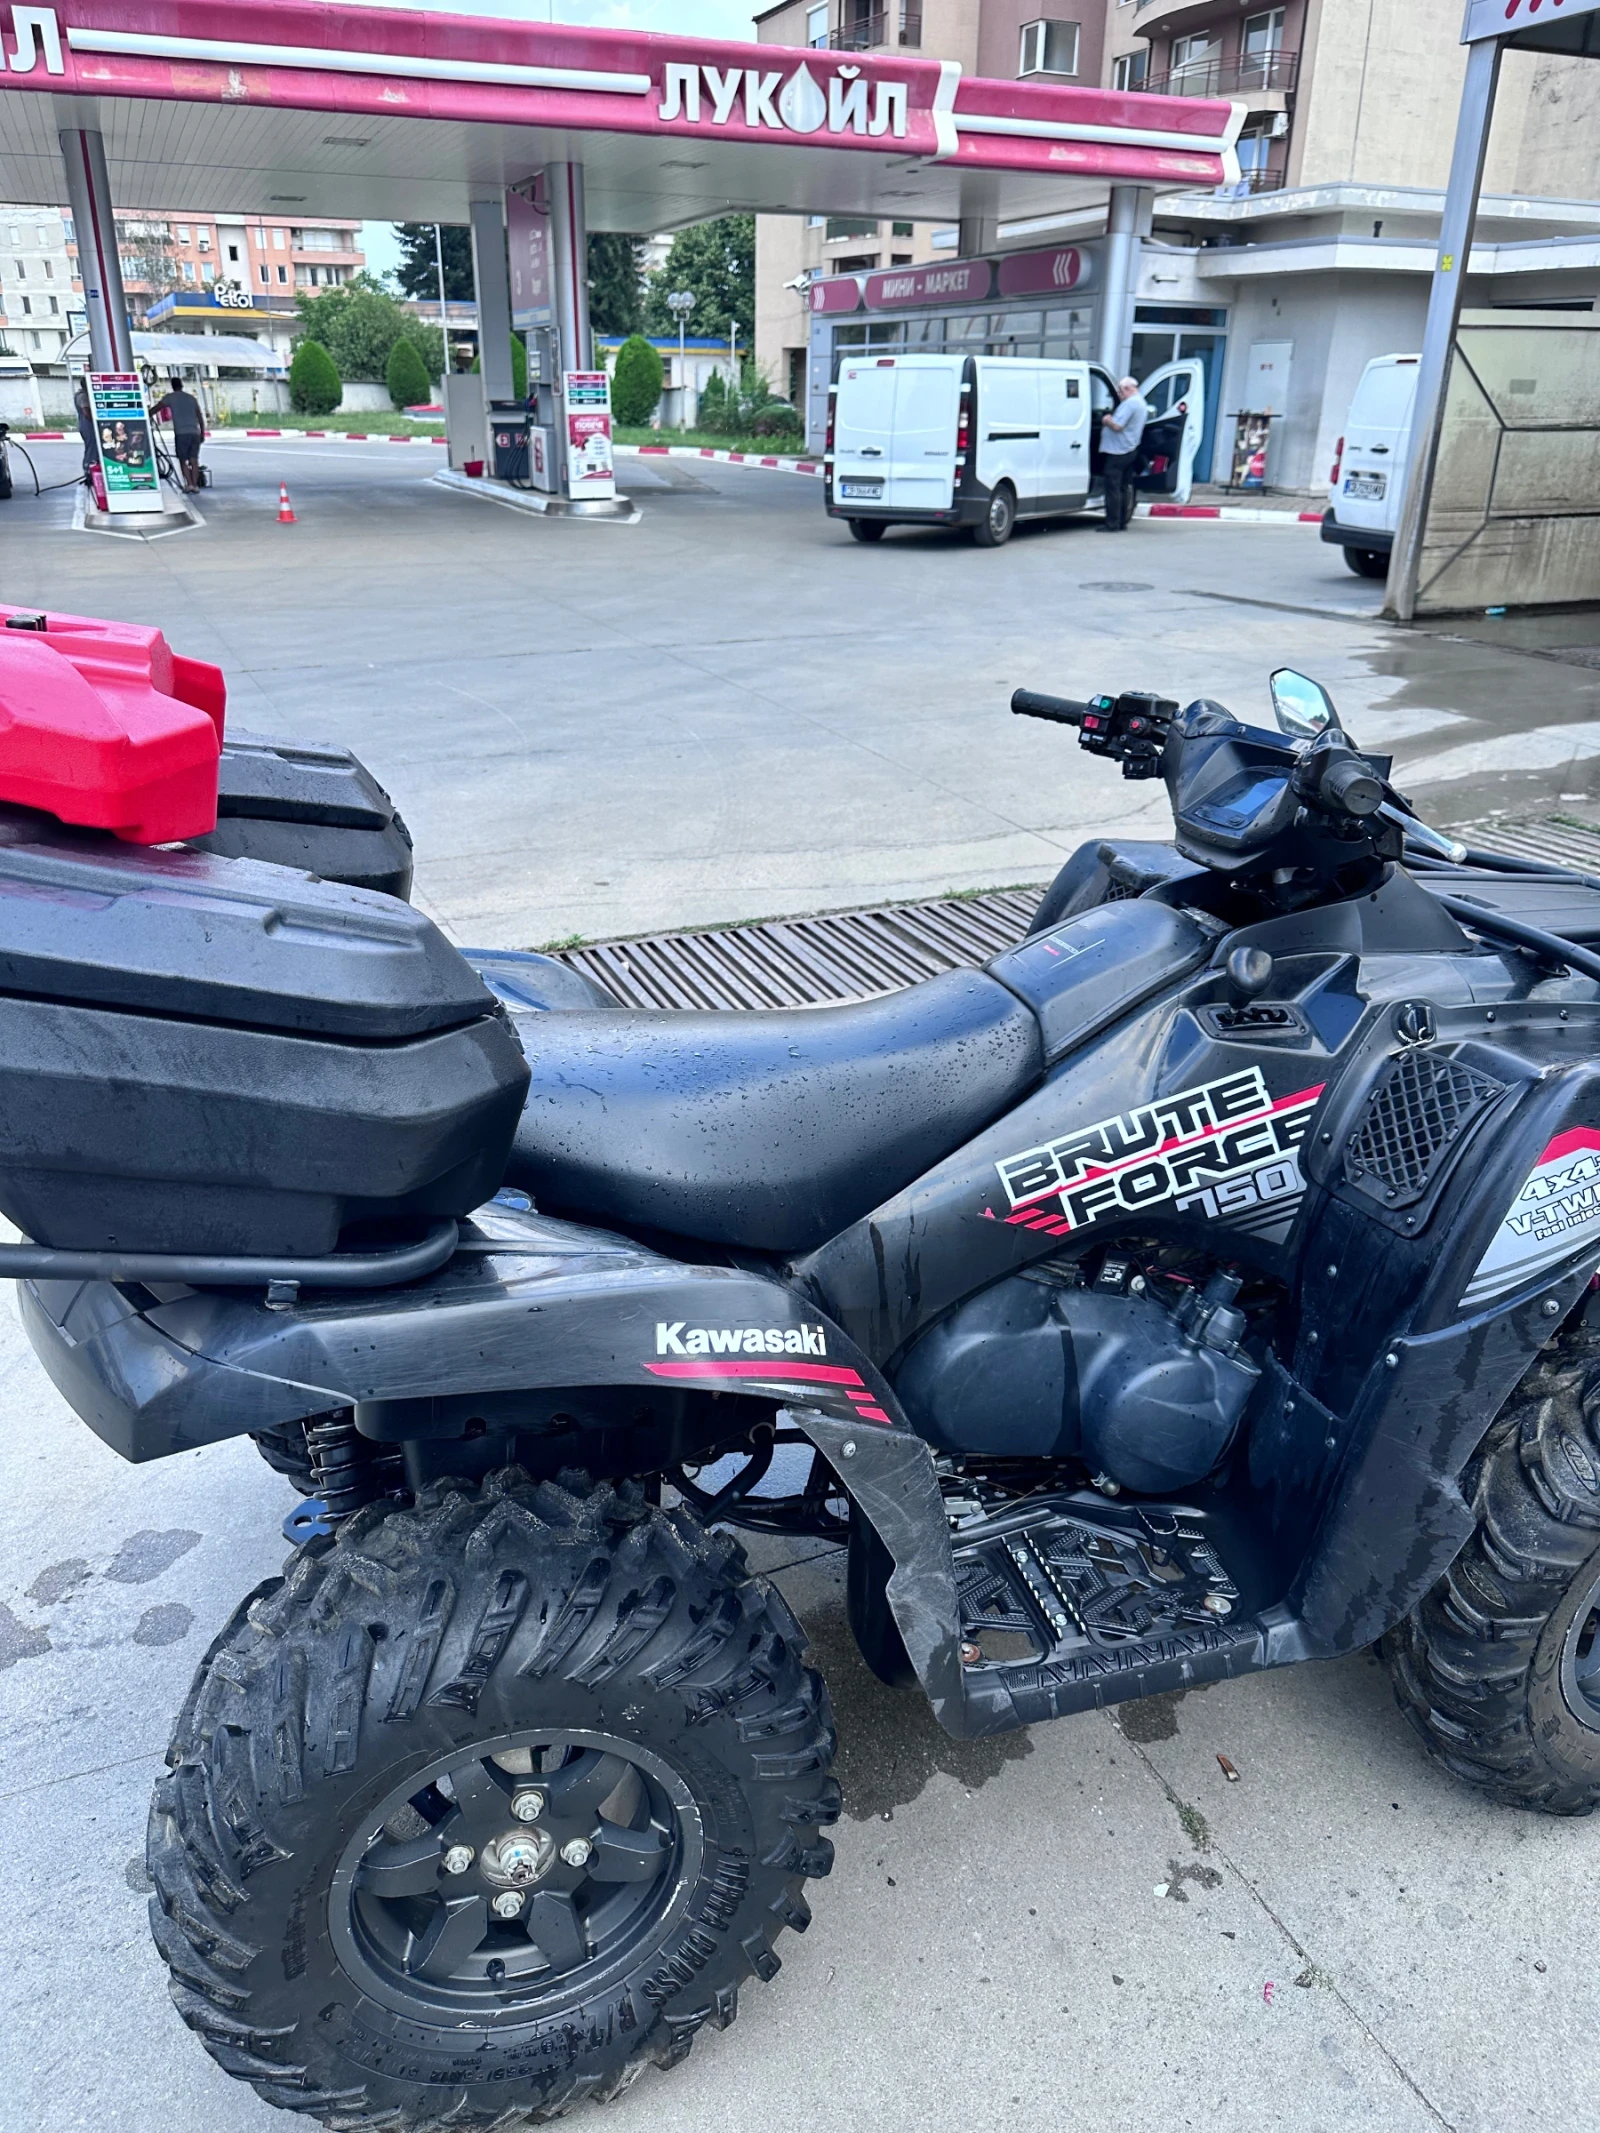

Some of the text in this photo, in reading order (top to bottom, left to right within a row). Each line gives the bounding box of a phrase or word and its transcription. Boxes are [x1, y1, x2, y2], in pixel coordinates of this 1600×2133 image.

[0, 5, 65, 76] Л
[214, 283, 254, 308] Petrol
[882, 277, 915, 299] МИНИ
[924, 269, 970, 294] МАРКЕТ
[994, 1065, 1274, 1211] BRUTE
[1058, 1112, 1313, 1230] FORCE
[1175, 1159, 1300, 1219] 750
[1534, 1218, 1565, 1241] Fuel
[656, 1322, 827, 1356] Kawasaki
[639, 1928, 719, 2009] CROSS
